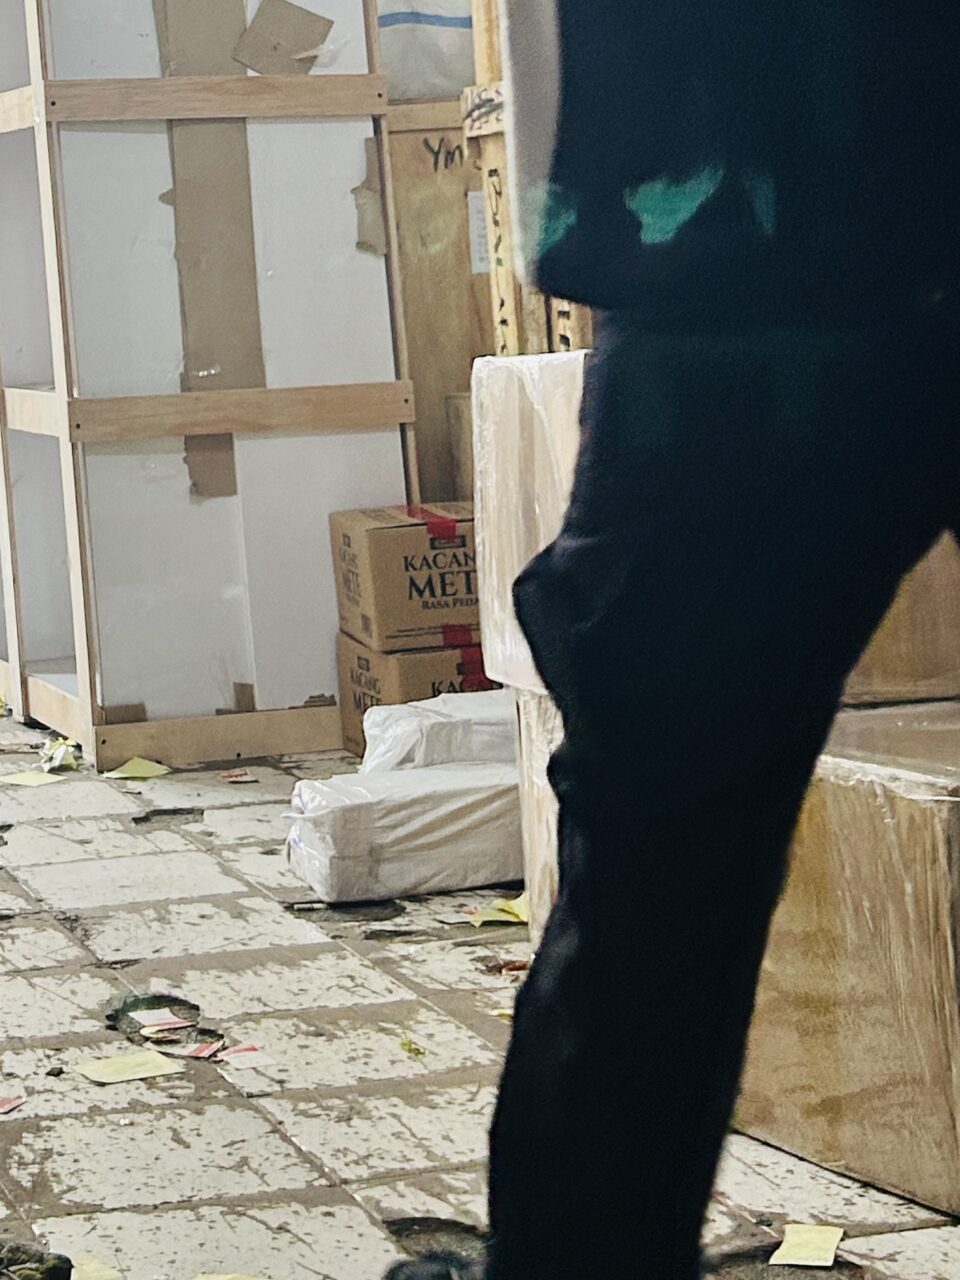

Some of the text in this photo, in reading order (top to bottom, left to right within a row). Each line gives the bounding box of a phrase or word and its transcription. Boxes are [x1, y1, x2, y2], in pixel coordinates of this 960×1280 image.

[403, 550, 478, 572] KACAN
[408, 570, 479, 601] MET
[452, 596, 480, 608] PEDA
